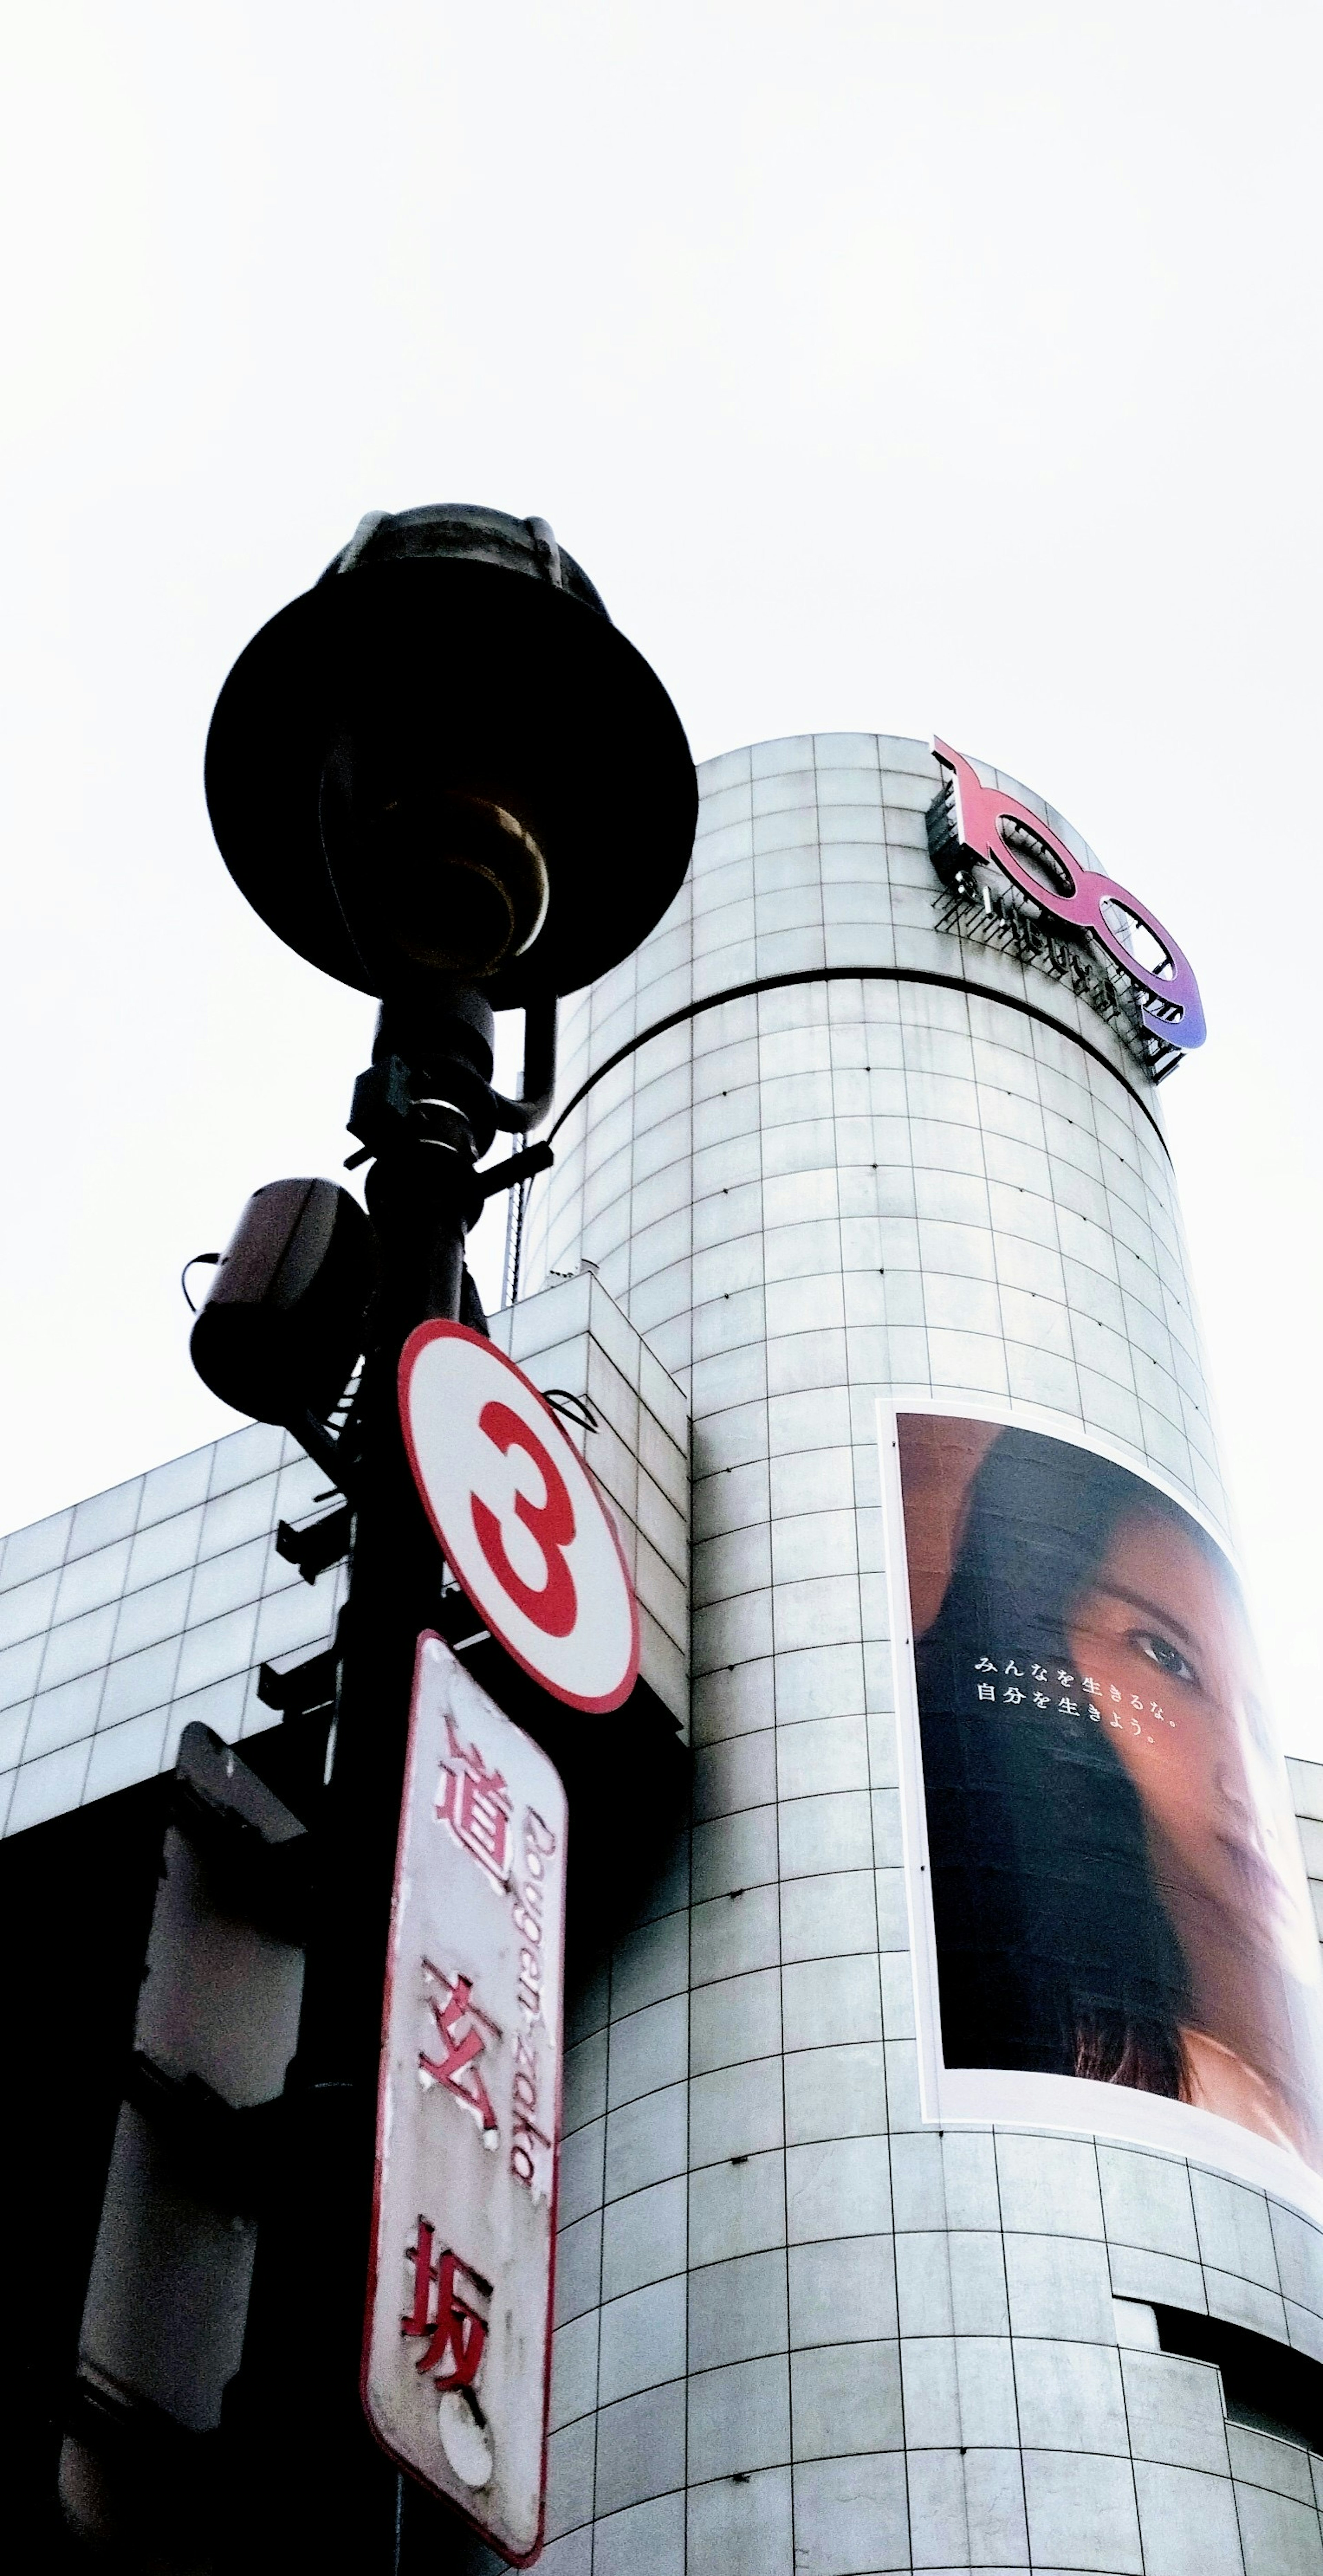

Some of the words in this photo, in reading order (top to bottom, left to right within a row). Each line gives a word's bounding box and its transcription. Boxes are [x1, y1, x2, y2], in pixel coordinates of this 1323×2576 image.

[930, 734, 1207, 1049] 109
[470, 1400, 578, 1638] 3
[974, 1657, 1177, 1728] みんなを生きるな。
[976, 1682, 1155, 1744] 自分を生きよう。
[400, 1713, 514, 2430] 道玄坂
